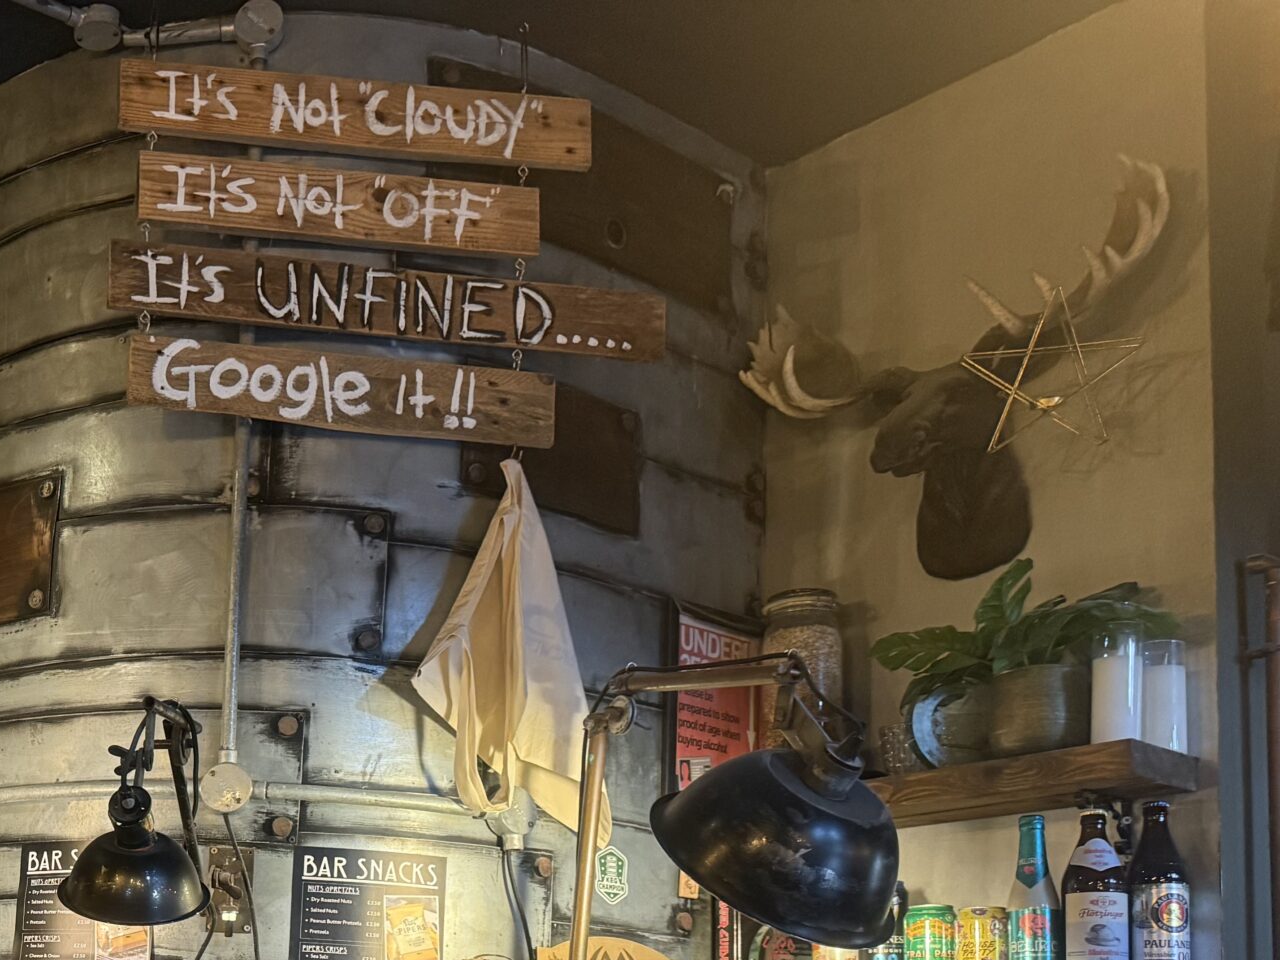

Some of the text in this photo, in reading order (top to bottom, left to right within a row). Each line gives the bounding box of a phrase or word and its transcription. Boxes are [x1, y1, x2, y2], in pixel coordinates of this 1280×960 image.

[151, 69, 238, 121] It's
[269, 82, 346, 136] Not
[156, 163, 257, 218] It's
[277, 173, 363, 228] Not
[130, 249, 232, 309] It's
[151, 338, 372, 424] Google
[679, 701, 711, 718] prepared
[721, 710, 741, 724] show
[677, 732, 728, 754] buying alcohol
[678, 718, 699, 732] proof
[707, 726, 720, 737] age
[721, 730, 741, 742] when
[27, 849, 62, 871] BAR
[303, 855, 438, 886] BAR SNACKS
[599, 883, 625, 893] CHAMPION
